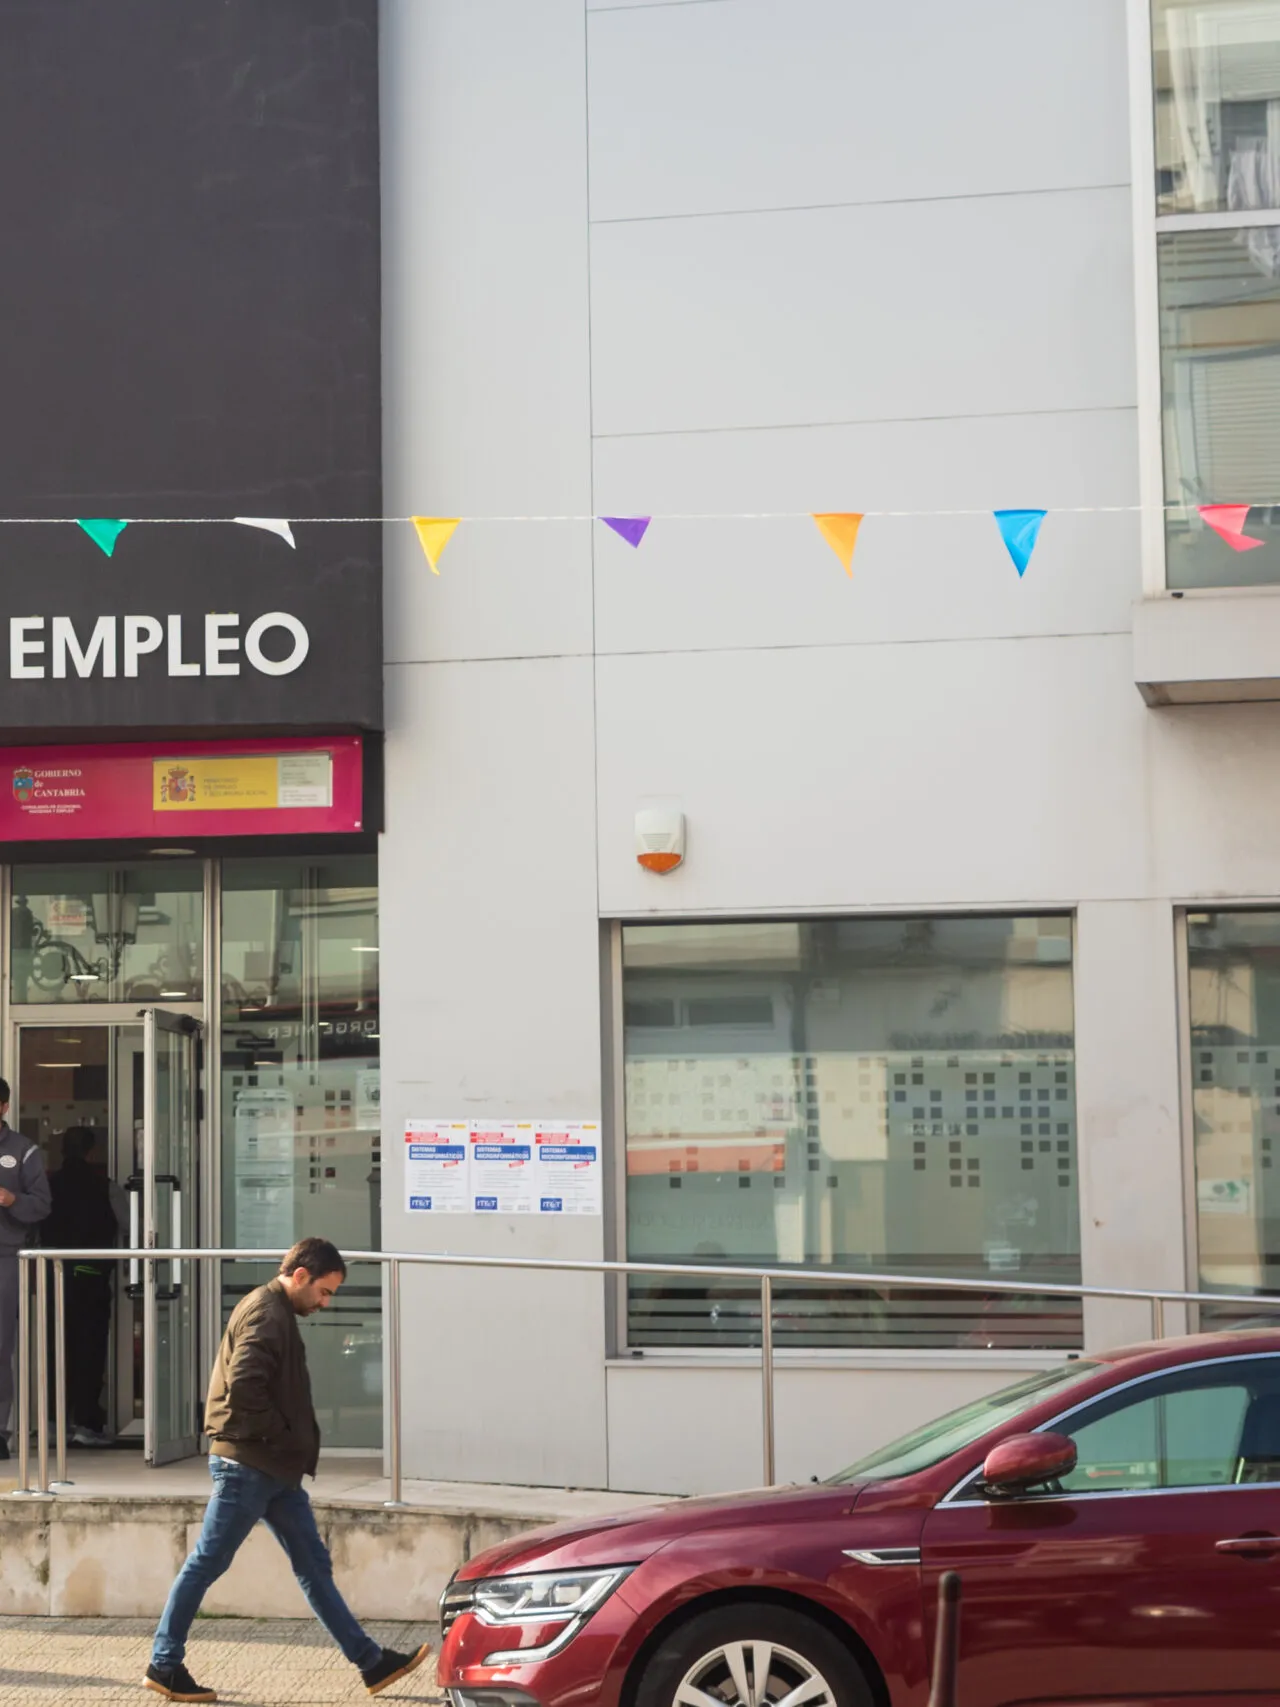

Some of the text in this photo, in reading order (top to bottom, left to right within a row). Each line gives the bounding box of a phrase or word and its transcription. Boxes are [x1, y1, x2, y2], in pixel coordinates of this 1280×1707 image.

[9, 611, 310, 679] EMPLEO
[34, 769, 82, 778] GOBIERNO
[34, 780, 44, 788] de
